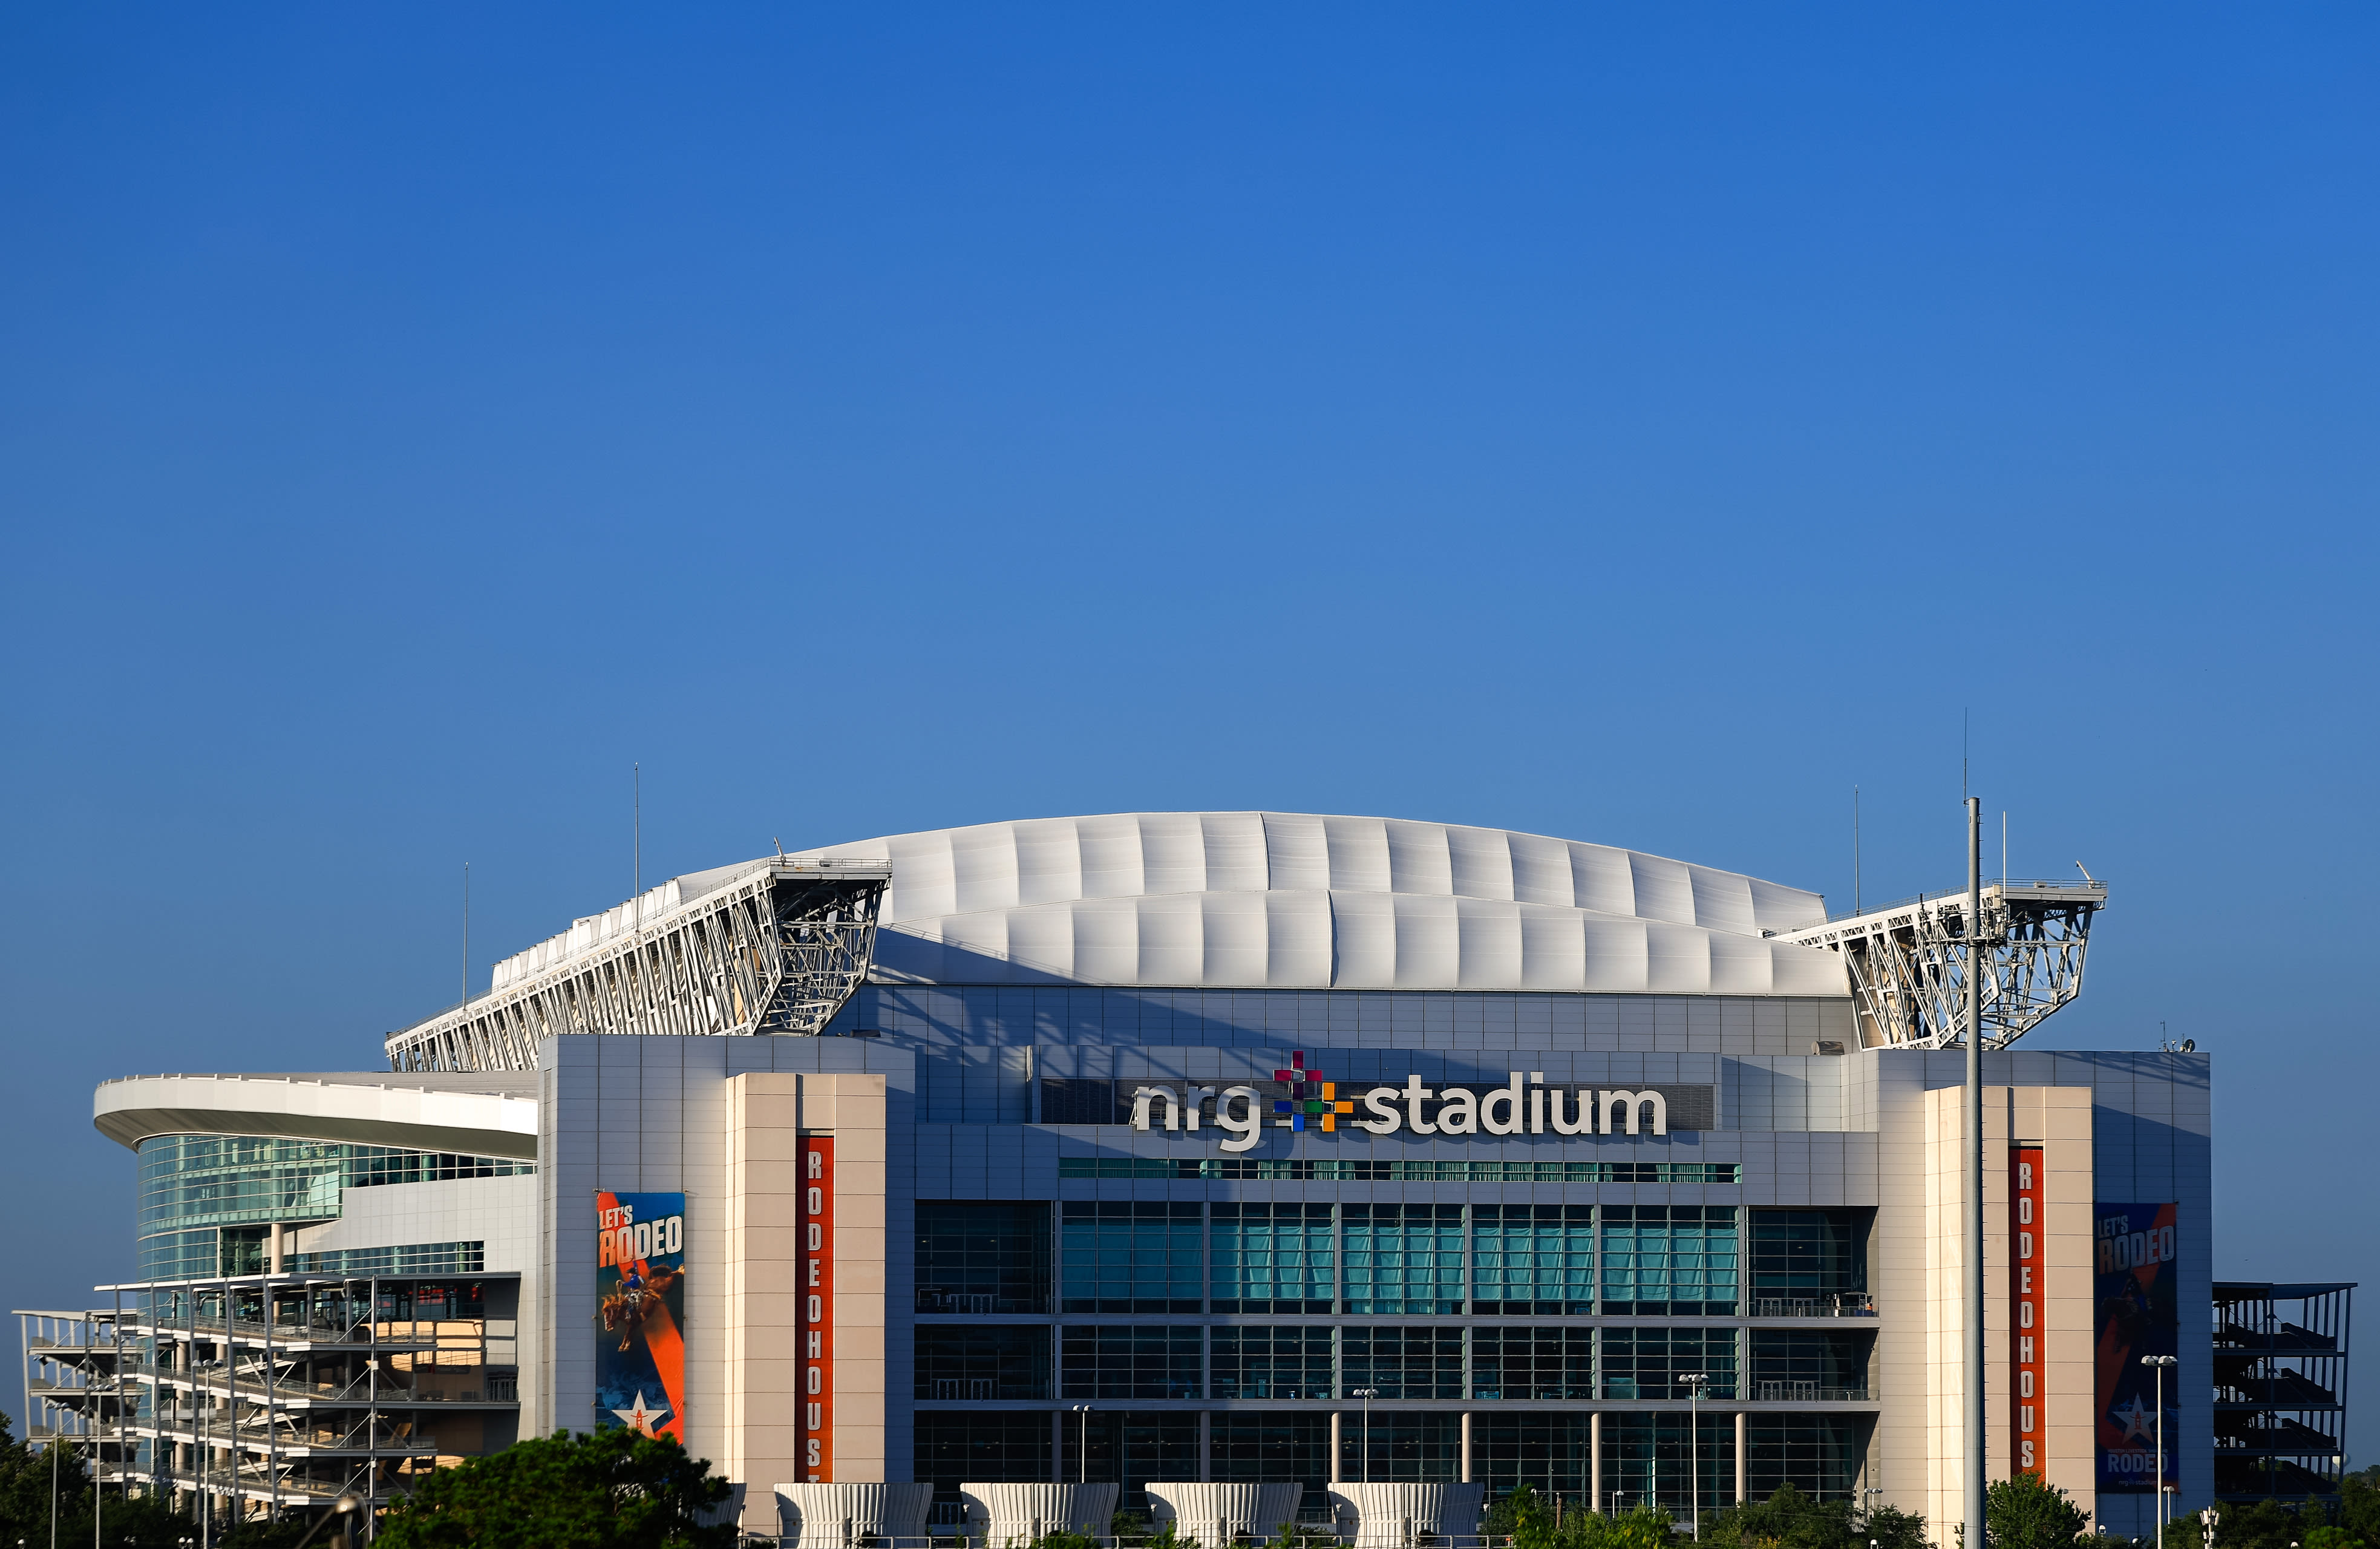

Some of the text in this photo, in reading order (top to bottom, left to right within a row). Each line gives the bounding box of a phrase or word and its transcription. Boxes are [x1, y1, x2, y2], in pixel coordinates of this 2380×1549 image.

[1136, 1071, 1667, 1152] nrg stadium
[599, 1205, 633, 1230] LET'S
[600, 1216, 682, 1268] RODEO
[2098, 1215, 2128, 1239] LET'S
[2099, 1225, 2174, 1274] RODEO
[807, 1151, 822, 1483] RODEOHOUS
[2108, 1453, 2168, 1473] RODEO
